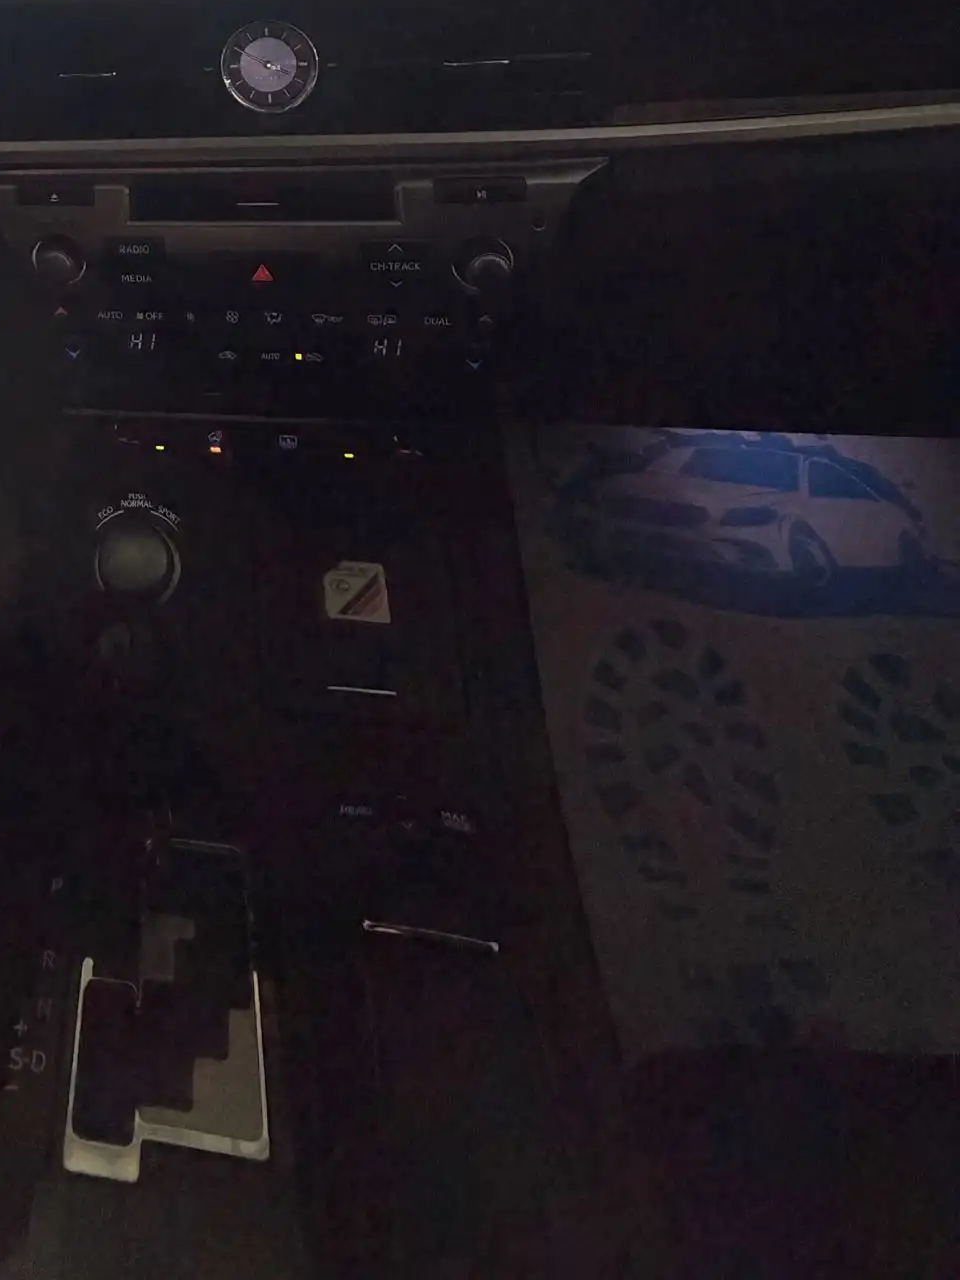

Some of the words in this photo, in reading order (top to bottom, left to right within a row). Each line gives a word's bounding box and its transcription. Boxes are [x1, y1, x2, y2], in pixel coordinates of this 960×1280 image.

[119, 244, 150, 255] RADIO
[121, 272, 153, 284] MEDIA
[97, 310, 123, 320] AUTO
[423, 316, 453, 327] DUAL
